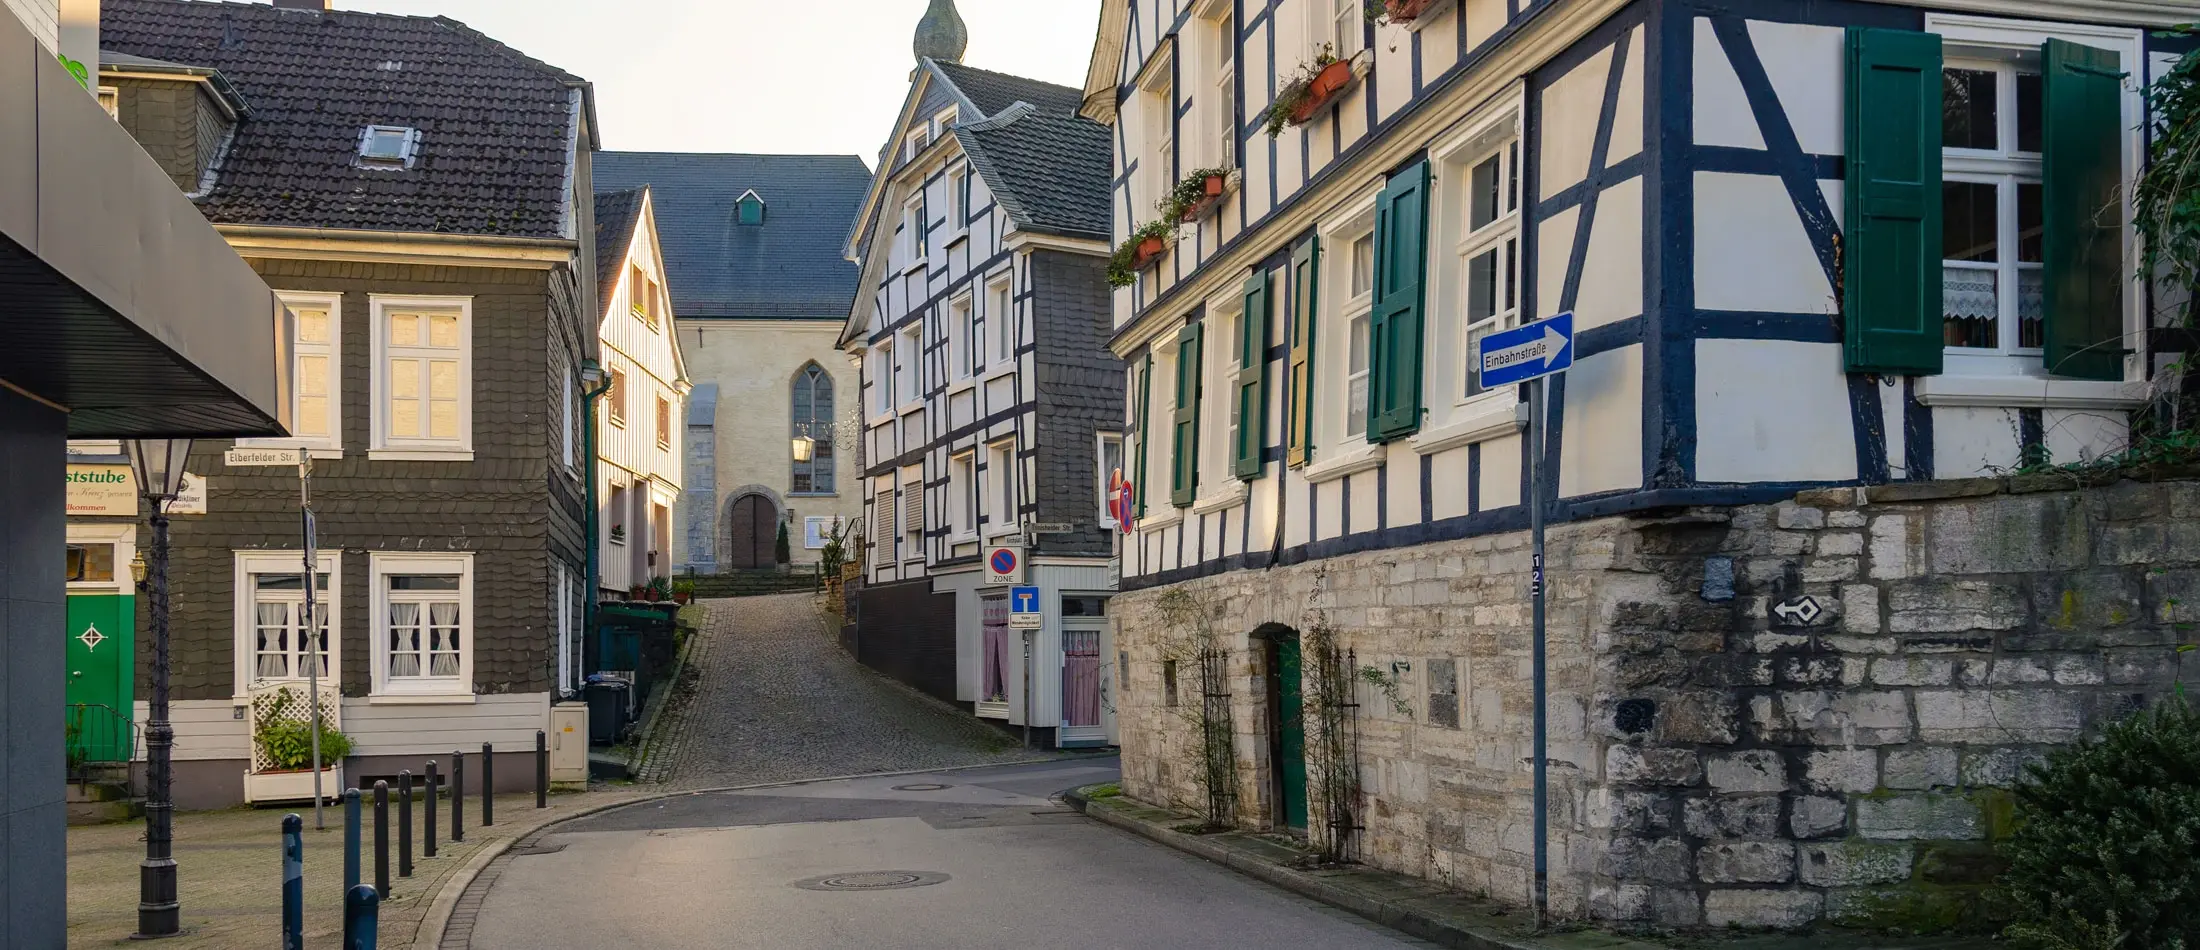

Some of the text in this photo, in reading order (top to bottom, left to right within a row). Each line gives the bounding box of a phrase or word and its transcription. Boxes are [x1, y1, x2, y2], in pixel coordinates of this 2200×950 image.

[1485, 343, 1547, 368] Einbahnstraße
[229, 452, 296, 462] Elberfelder Str.
[994, 575, 1014, 583] ZONE
